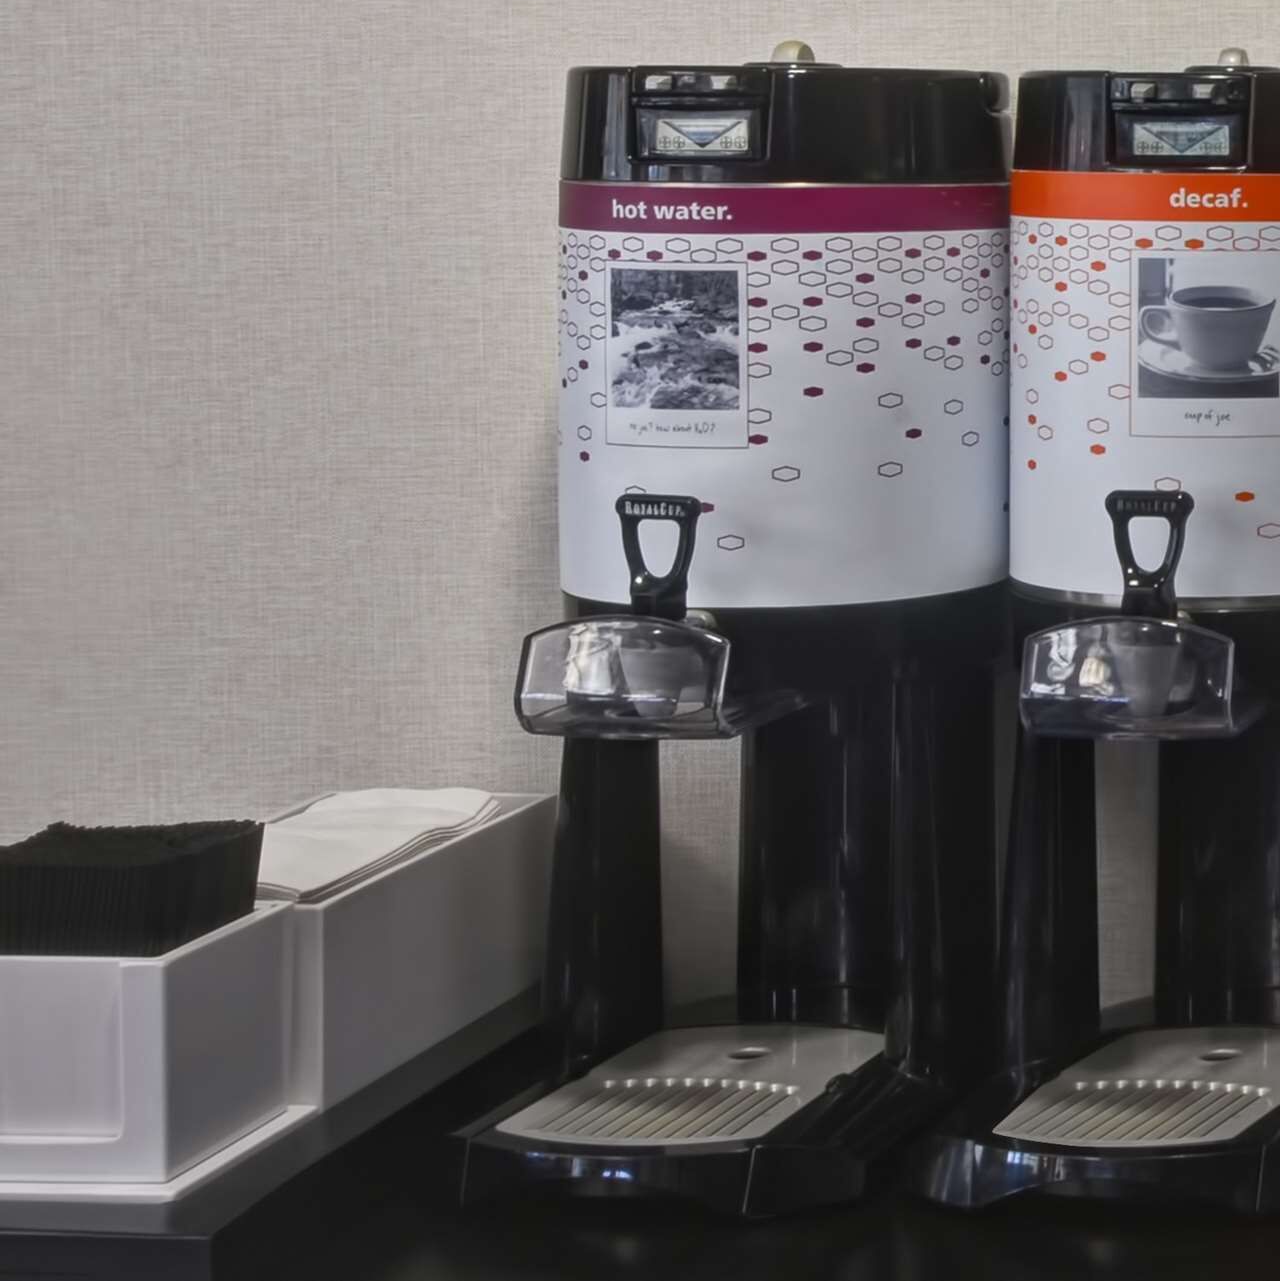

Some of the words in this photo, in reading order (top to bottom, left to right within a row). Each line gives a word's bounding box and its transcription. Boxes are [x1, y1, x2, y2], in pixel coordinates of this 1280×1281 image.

[1169, 187, 1248, 208] decaf.
[612, 199, 648, 219] hot
[653, 202, 733, 220] water.
